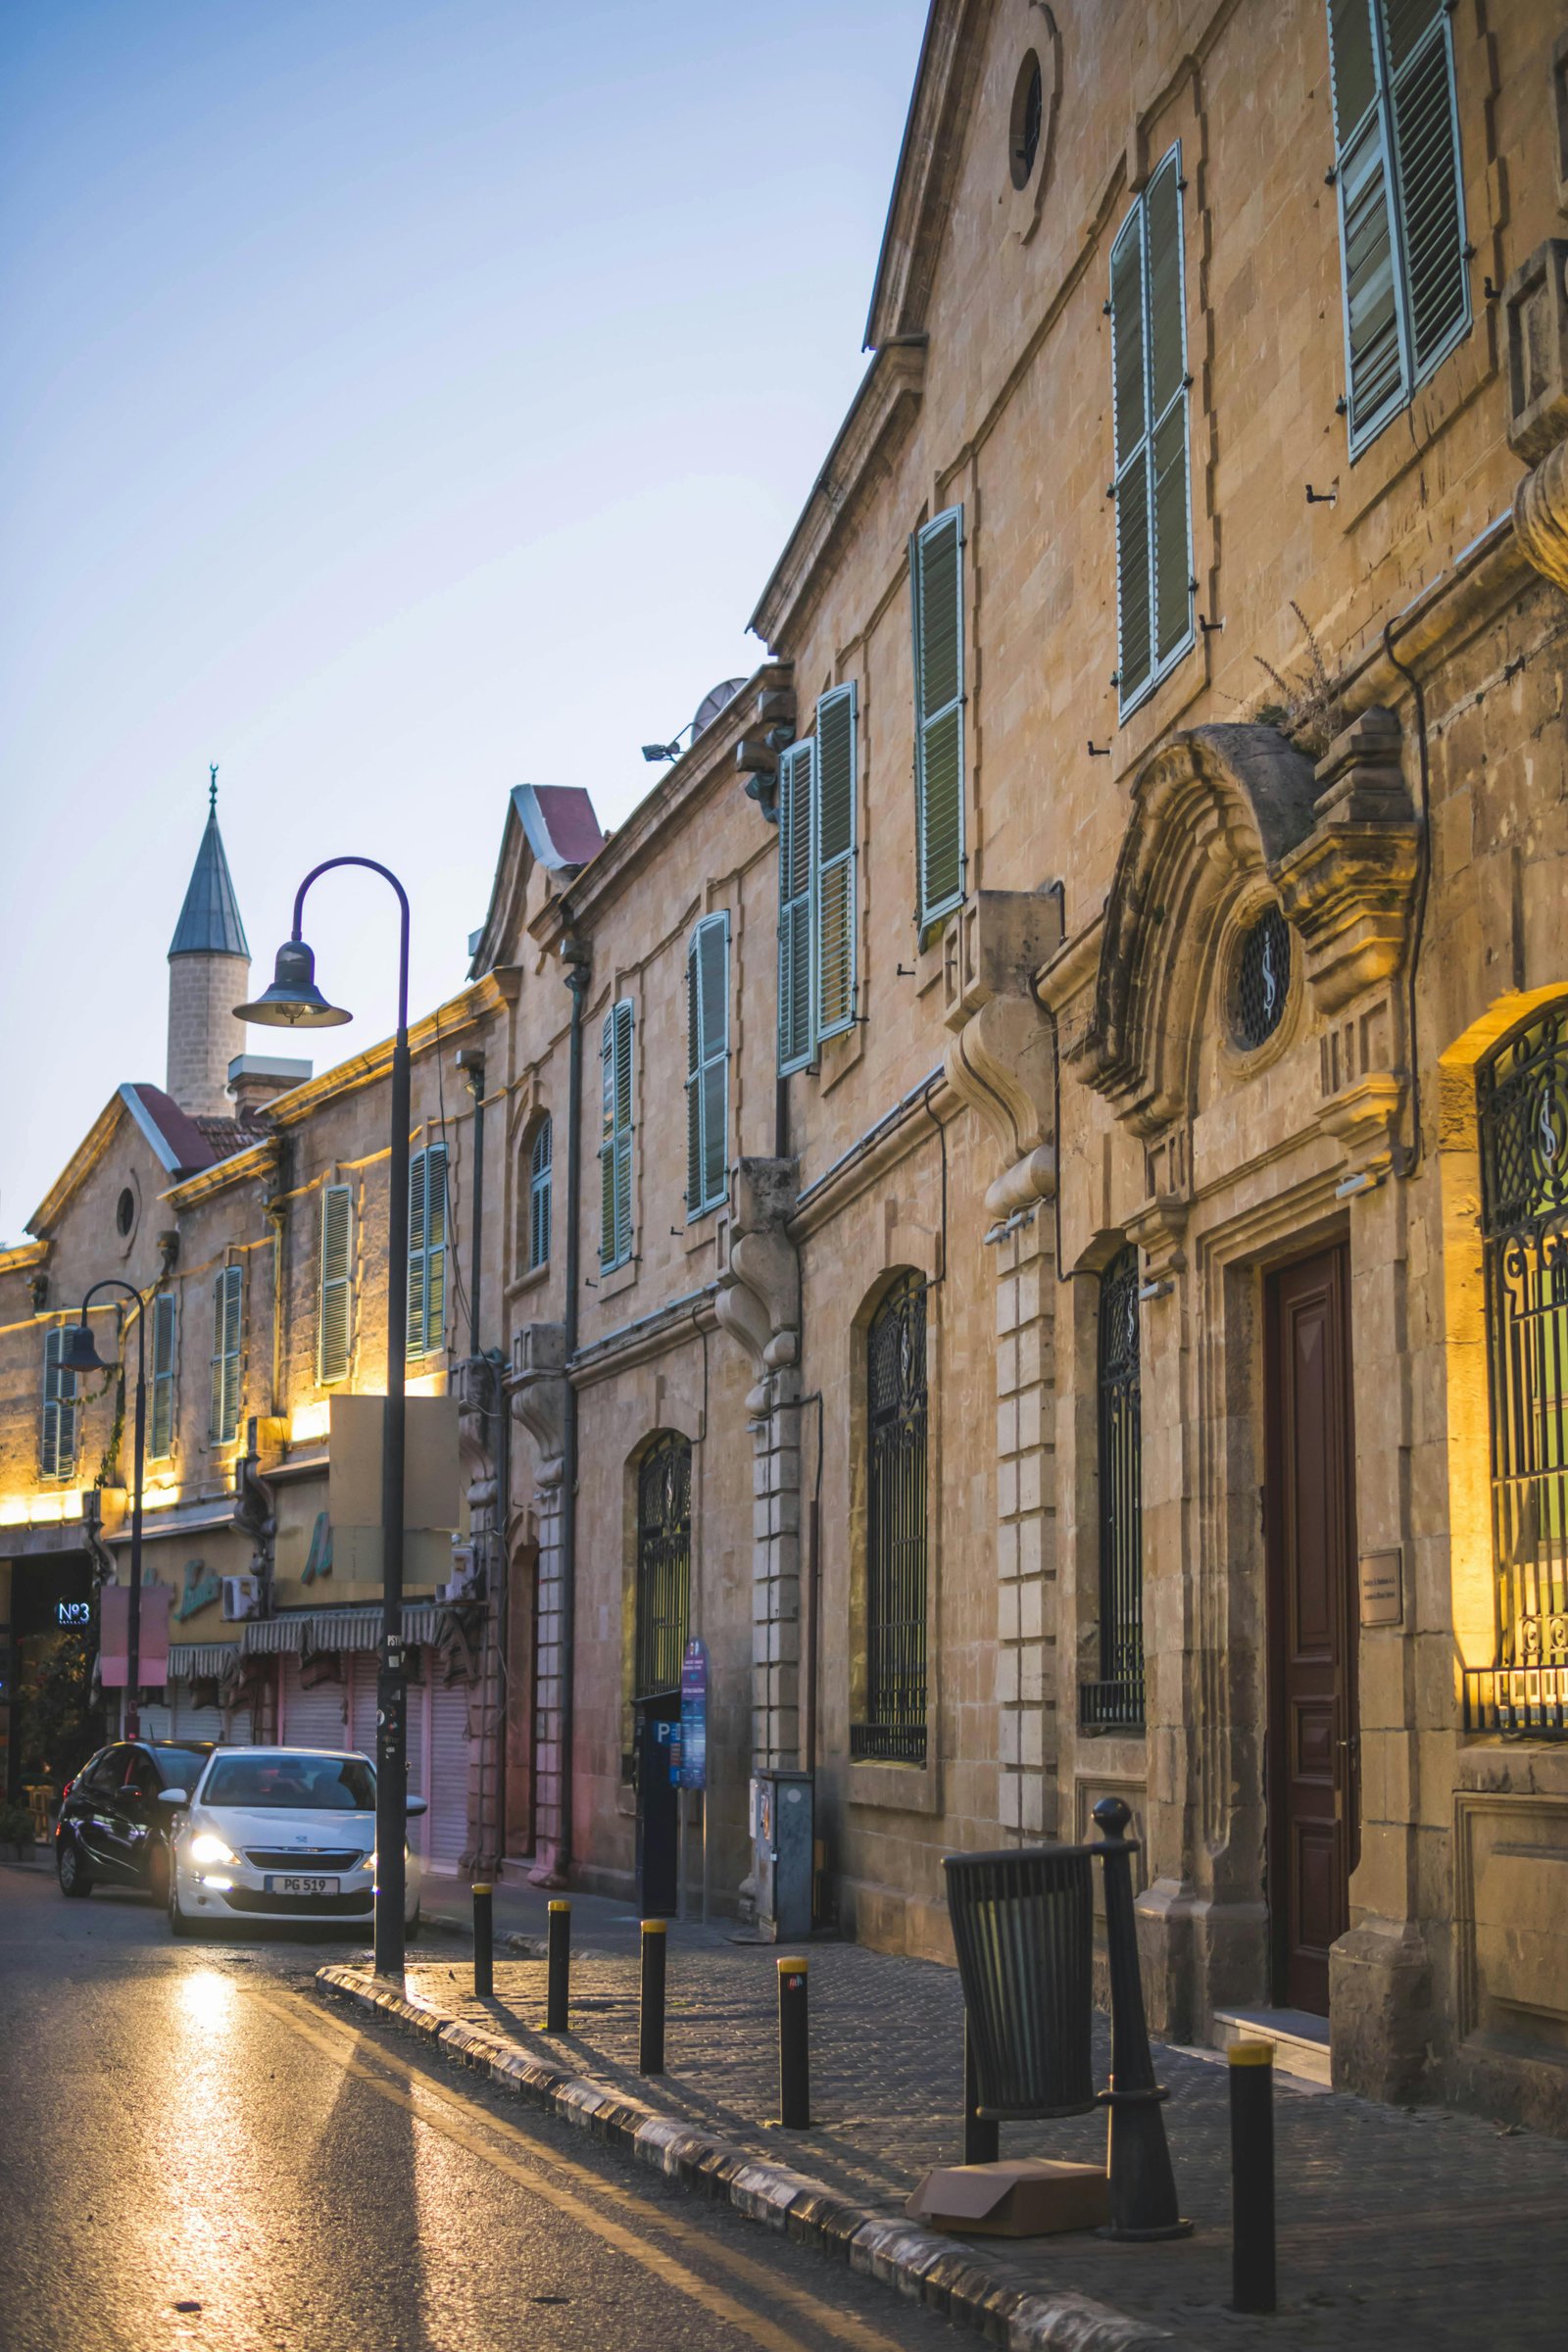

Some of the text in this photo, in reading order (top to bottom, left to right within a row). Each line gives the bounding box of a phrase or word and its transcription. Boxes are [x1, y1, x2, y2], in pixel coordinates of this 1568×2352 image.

[658, 1723, 670, 1742] P
[284, 1879, 326, 1891] PG 519
